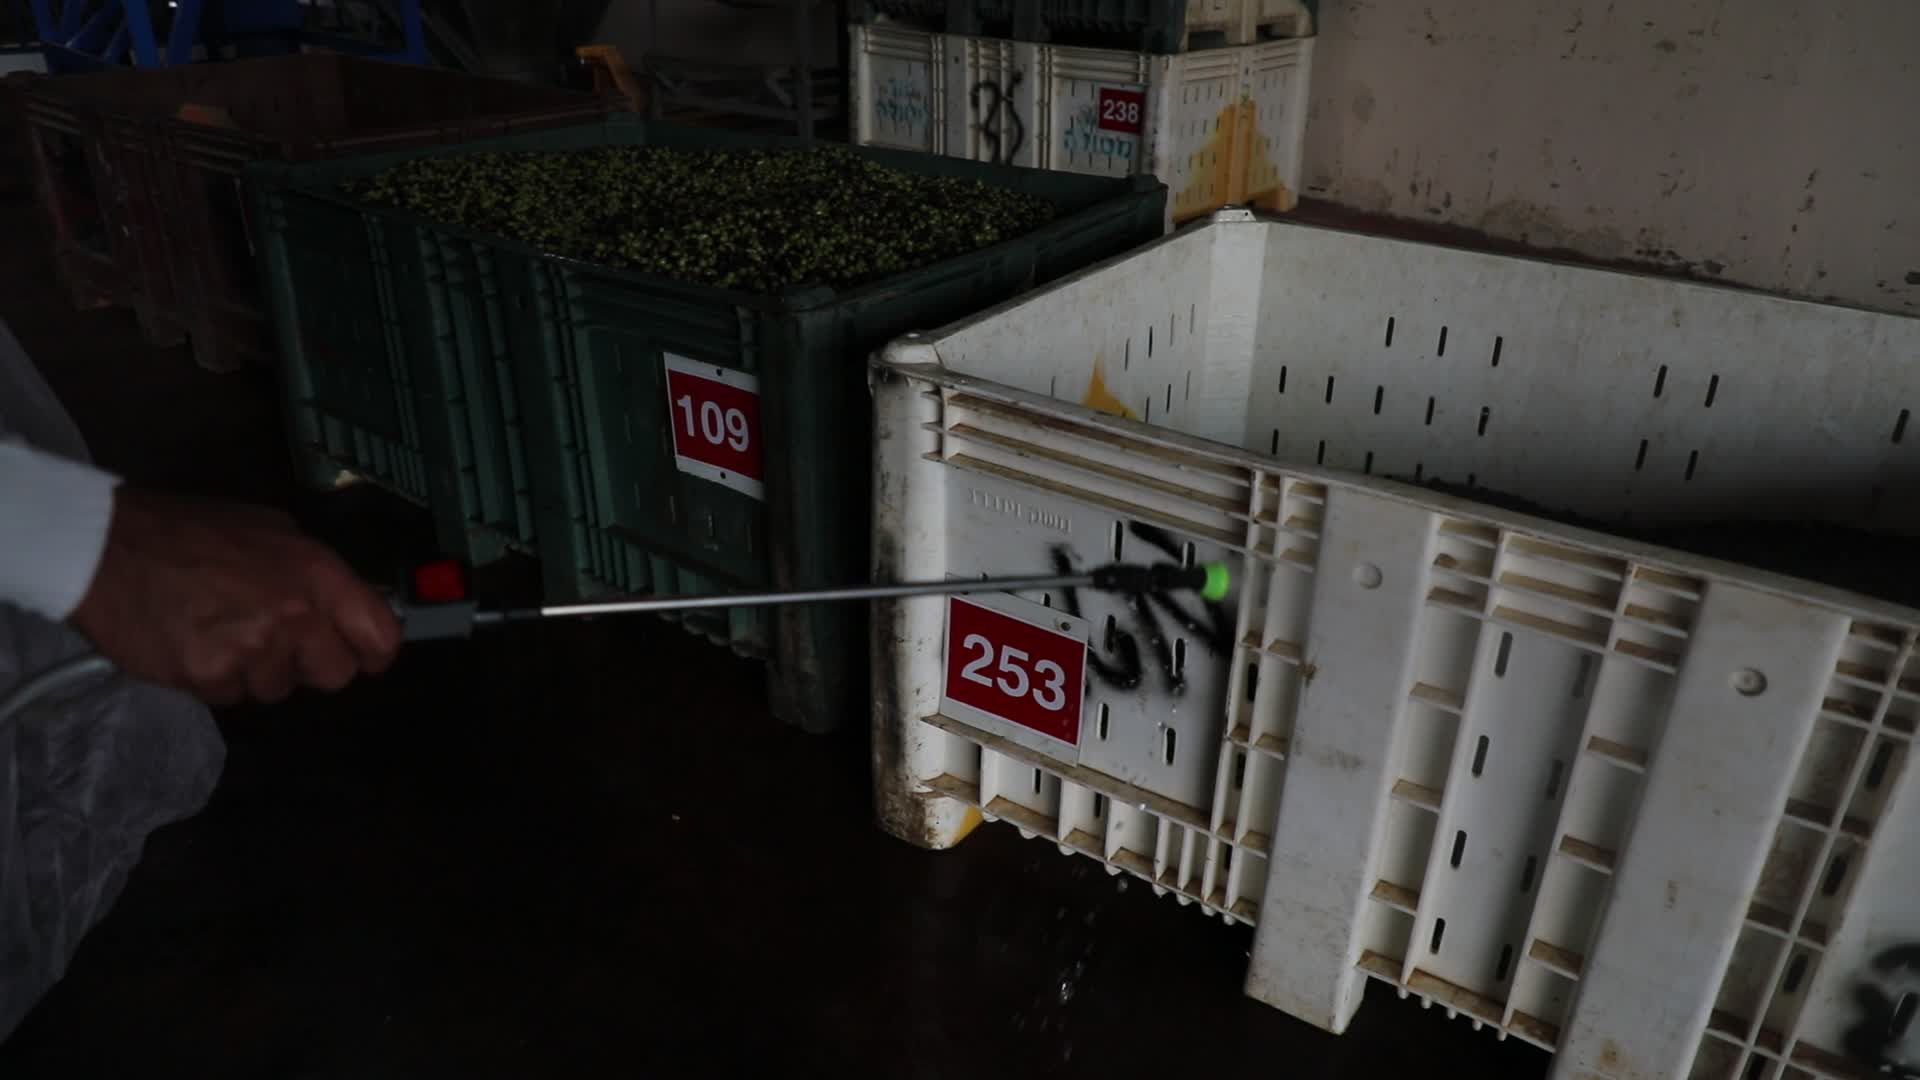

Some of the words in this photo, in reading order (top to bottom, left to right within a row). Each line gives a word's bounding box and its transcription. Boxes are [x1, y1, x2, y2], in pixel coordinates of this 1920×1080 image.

[1102, 99, 1139, 124] 238
[676, 394, 750, 452] 109
[960, 633, 1066, 711] 253
